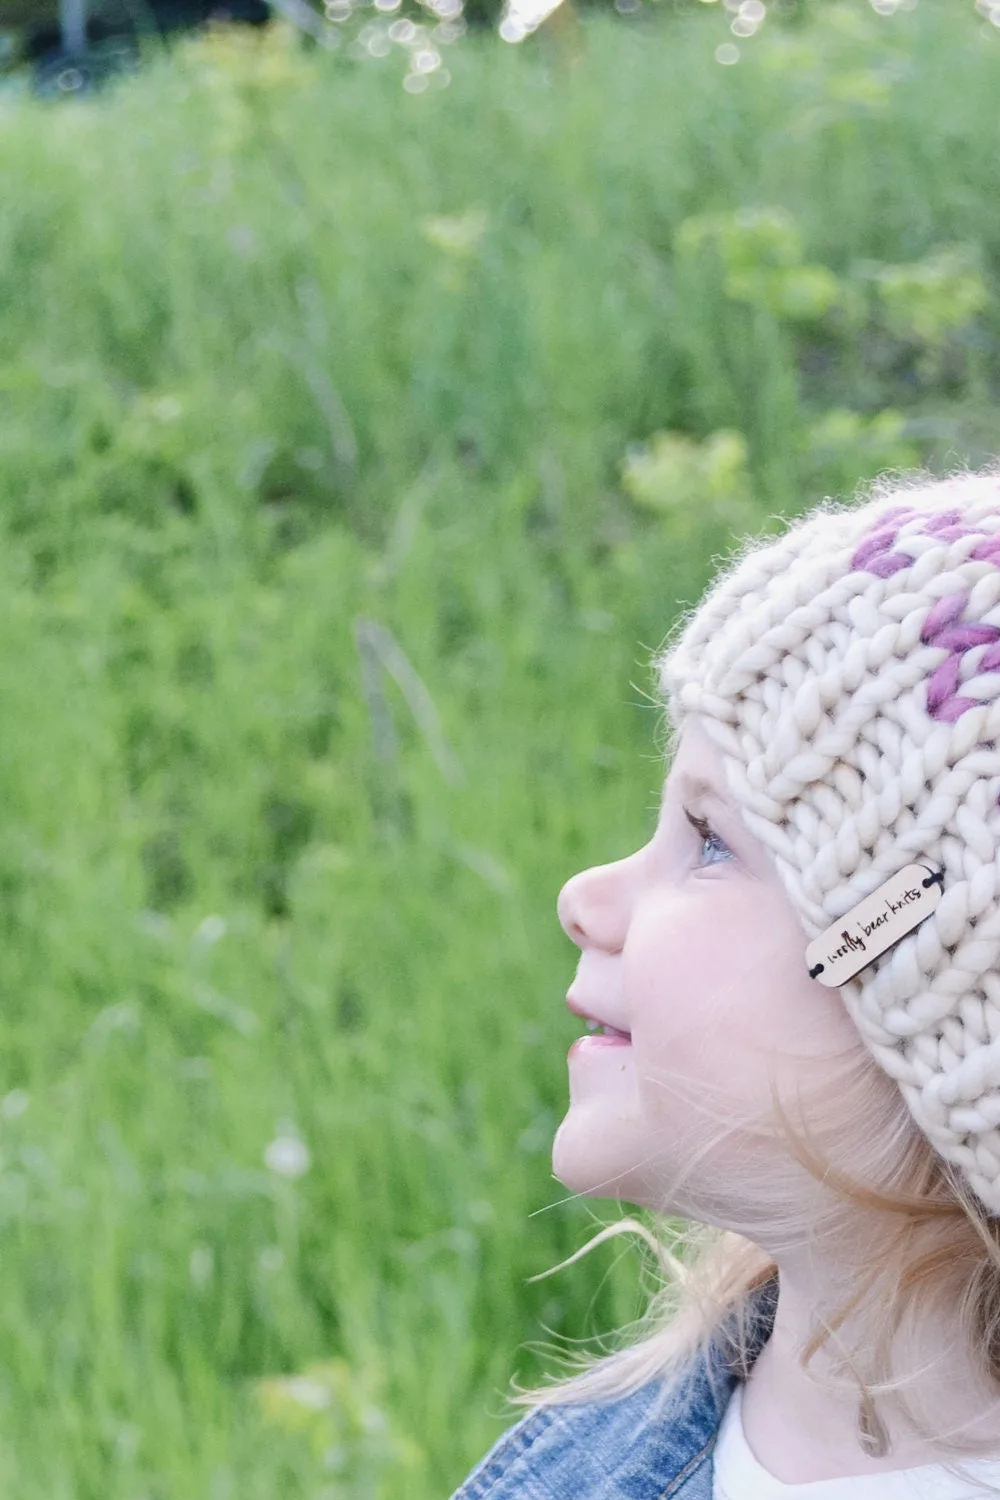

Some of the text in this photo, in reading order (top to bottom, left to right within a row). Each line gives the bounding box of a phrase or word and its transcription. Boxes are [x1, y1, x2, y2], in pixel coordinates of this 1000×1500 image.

[827, 888, 921, 963] woolly bear knits
